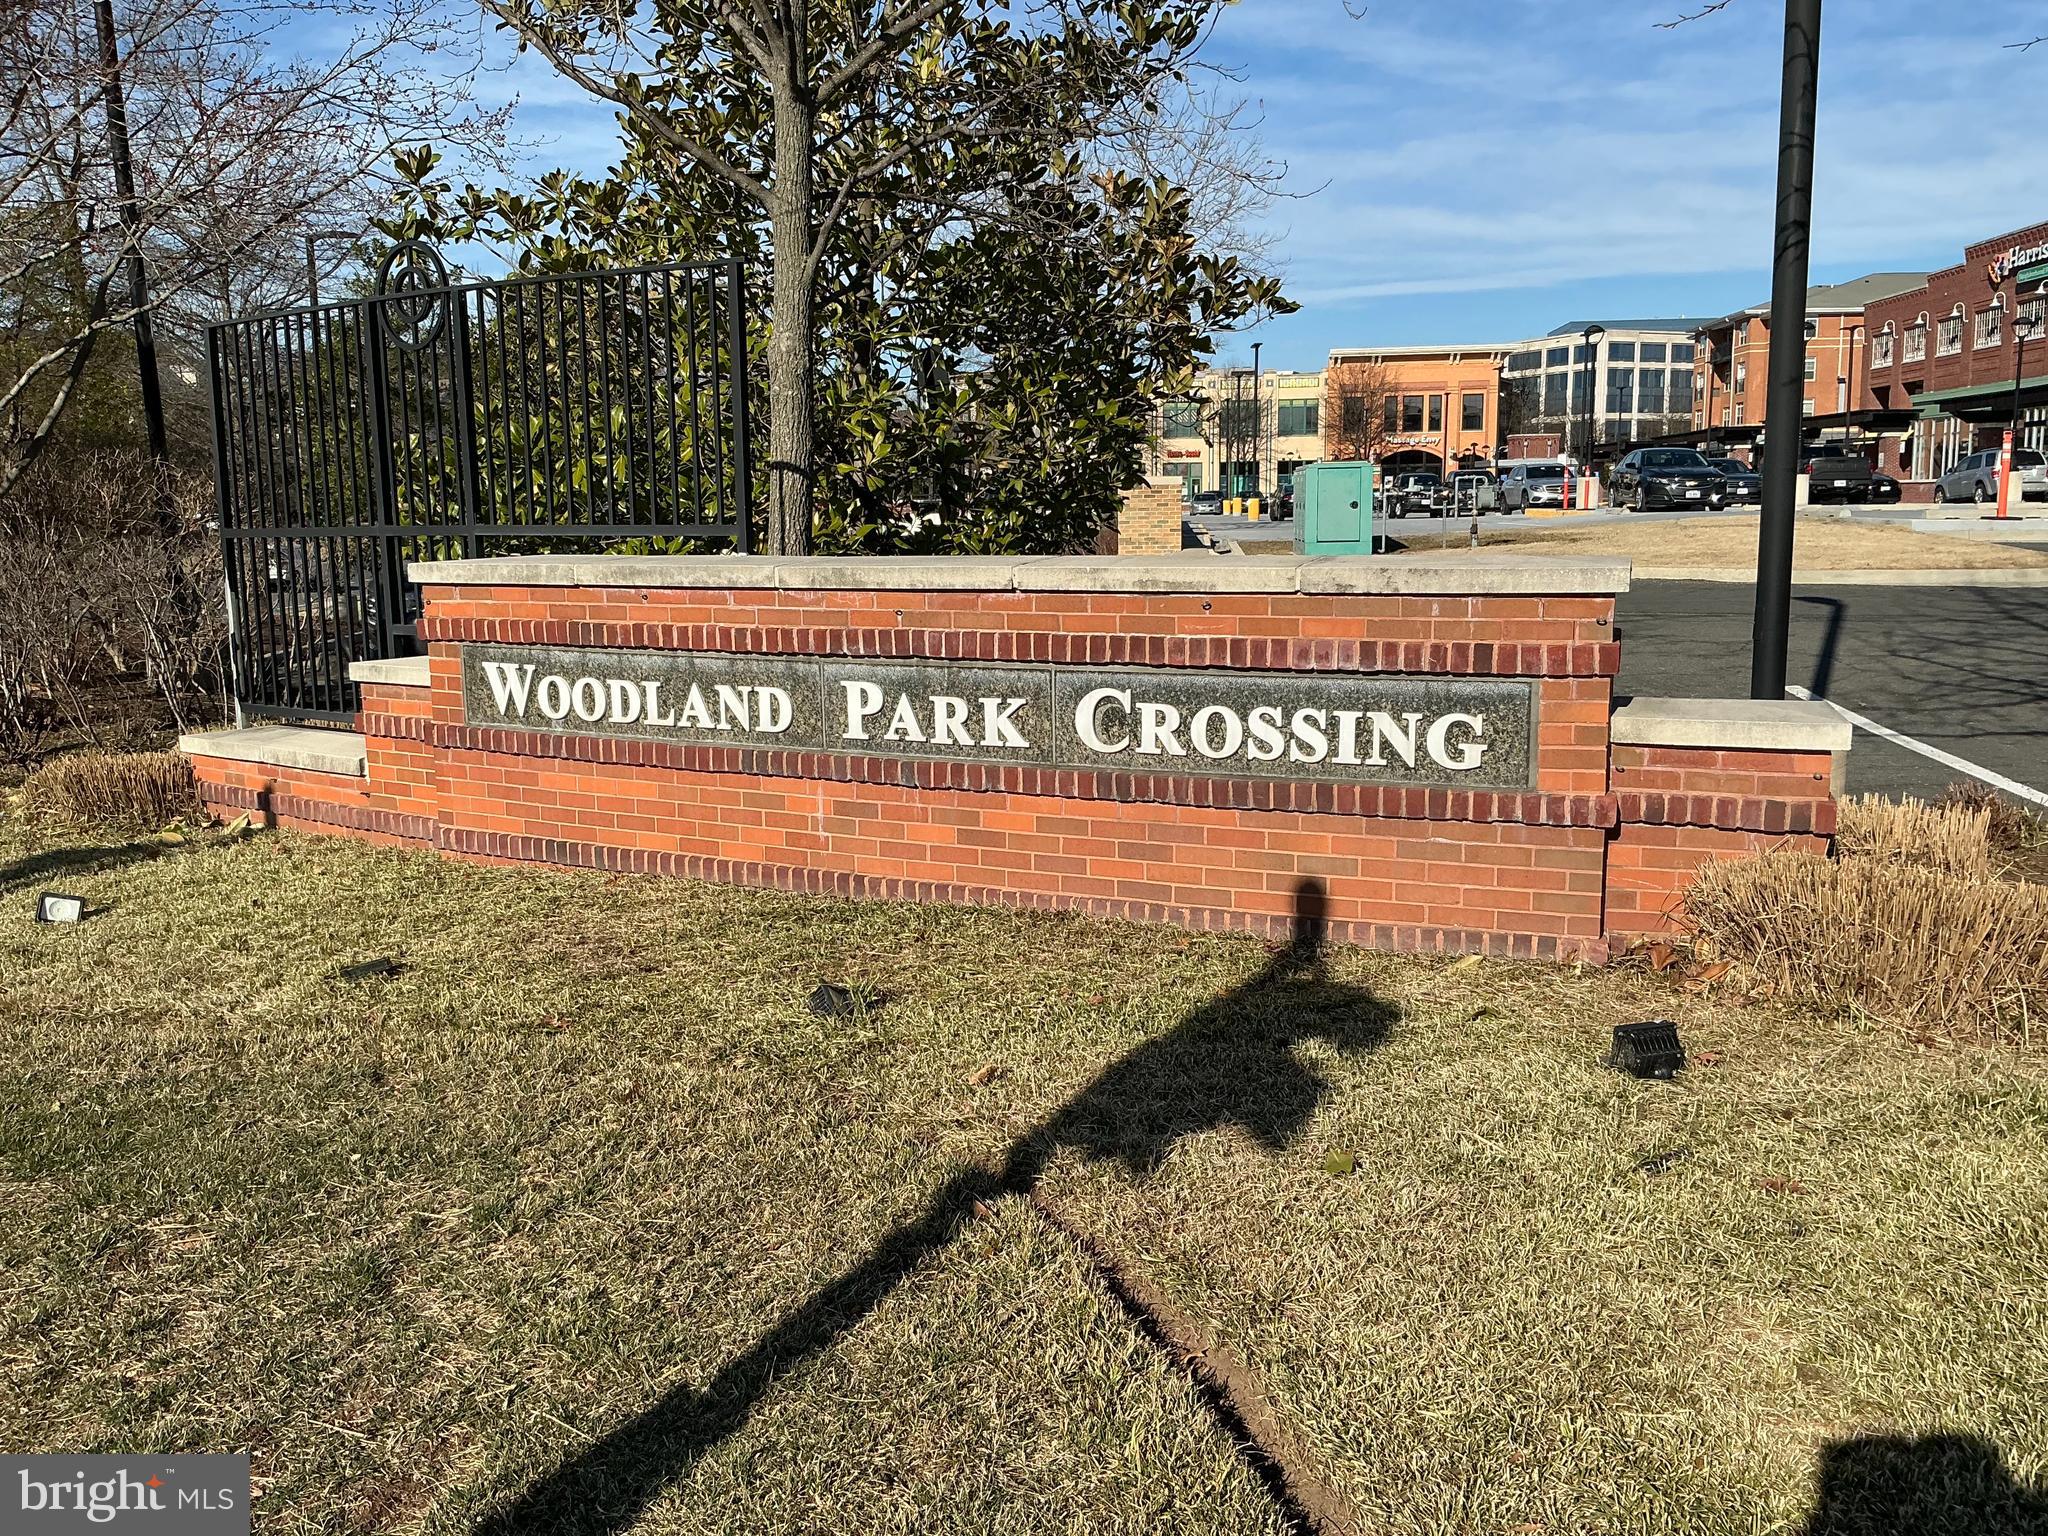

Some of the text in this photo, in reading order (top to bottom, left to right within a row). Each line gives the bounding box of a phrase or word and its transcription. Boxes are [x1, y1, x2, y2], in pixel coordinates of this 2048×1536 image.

[2008, 240, 2048, 269] Harris
[1385, 435, 1441, 446] Massage Envy
[481, 661, 1488, 770] WOODLAND PARK CROSSING
